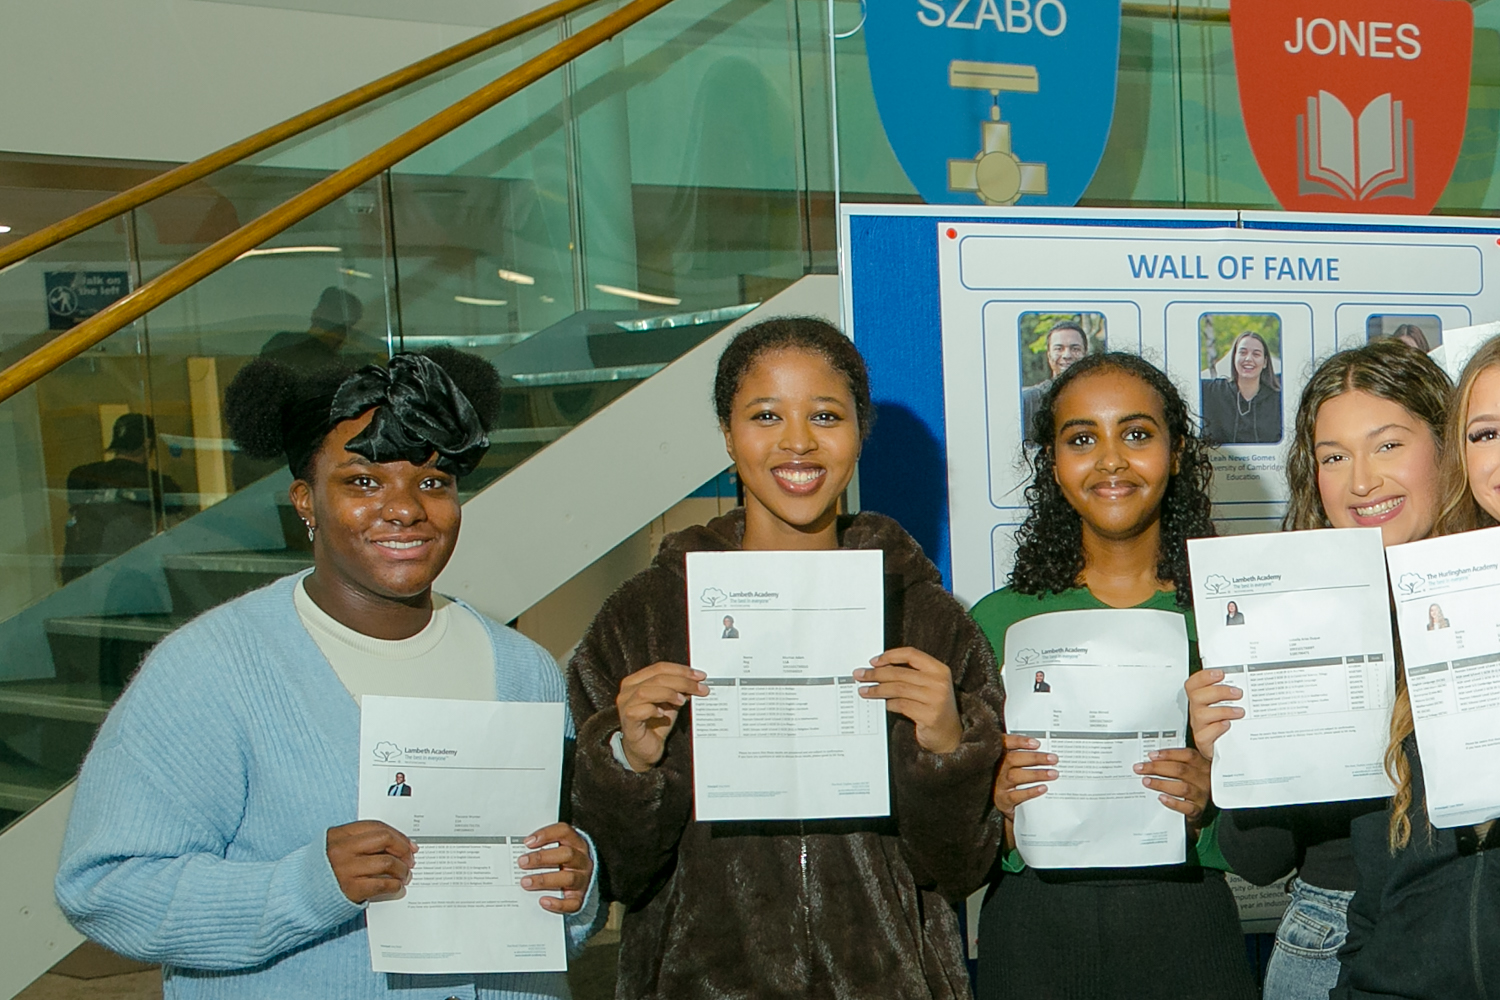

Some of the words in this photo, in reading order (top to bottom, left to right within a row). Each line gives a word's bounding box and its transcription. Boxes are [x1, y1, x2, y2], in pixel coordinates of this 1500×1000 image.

[917, 0, 1067, 36] SZABO
[1284, 17, 1422, 61] JONES
[1127, 253, 1209, 280] WALL
[1216, 254, 1258, 281] OF
[1263, 256, 1340, 282] FAME
[100, 286, 119, 295] left
[1251, 454, 1276, 462] Gomes
[1246, 463, 1285, 472] Cambridge
[1438, 567, 1471, 578] Hurlingham
[1472, 563, 1498, 572] Academy
[1232, 575, 1257, 583] Lambeth
[754, 591, 779, 599] Academy
[1041, 647, 1064, 655] Lambeth
[431, 748, 457, 756] Academy
[1234, 893, 1258, 901] mputer
[1259, 891, 1285, 899] Science
